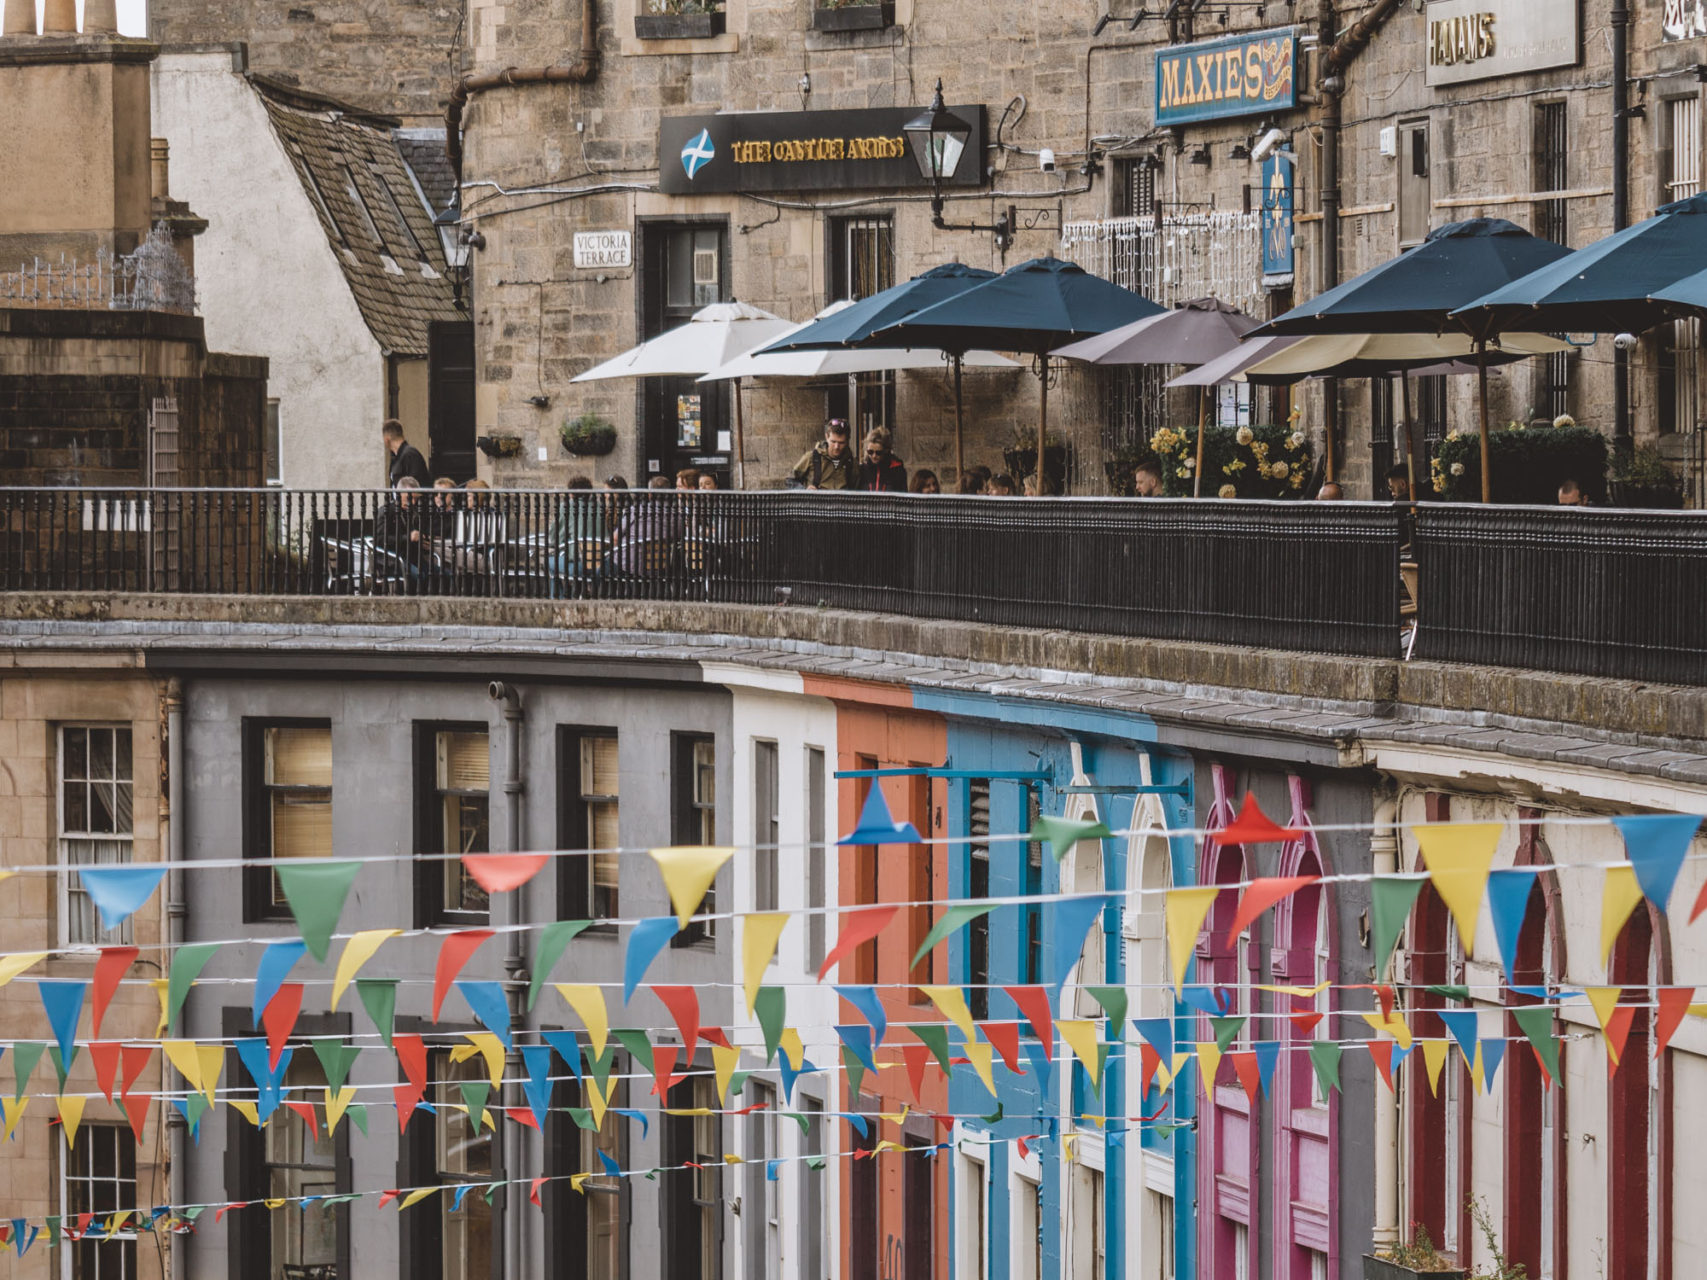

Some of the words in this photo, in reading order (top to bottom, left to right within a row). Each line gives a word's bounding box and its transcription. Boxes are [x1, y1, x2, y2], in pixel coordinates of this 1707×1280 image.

[1160, 44, 1262, 108] MAXIES
[731, 141, 771, 163] THE
[847, 136, 904, 159] ARMS
[578, 235, 627, 250] VICTORIA
[580, 250, 626, 265] TERRACE
